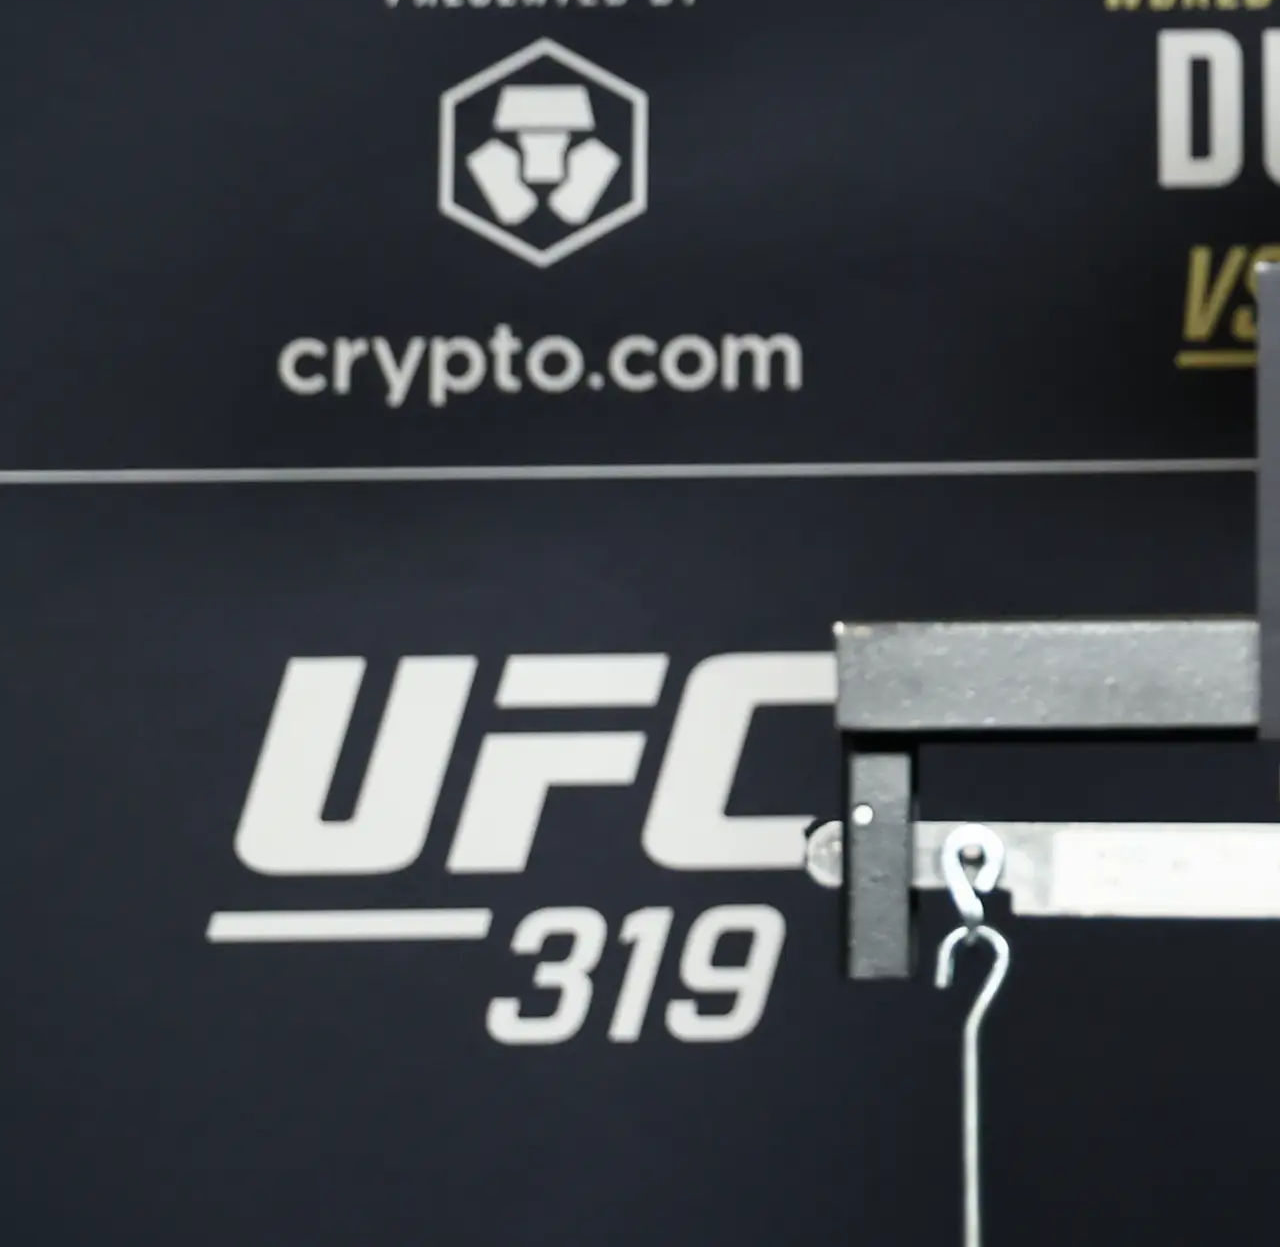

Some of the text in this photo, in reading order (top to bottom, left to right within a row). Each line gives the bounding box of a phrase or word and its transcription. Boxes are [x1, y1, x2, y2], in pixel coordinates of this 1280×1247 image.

[277, 322, 803, 409] crypto.com
[234, 650, 838, 876] UFC
[484, 903, 787, 1046] 319
